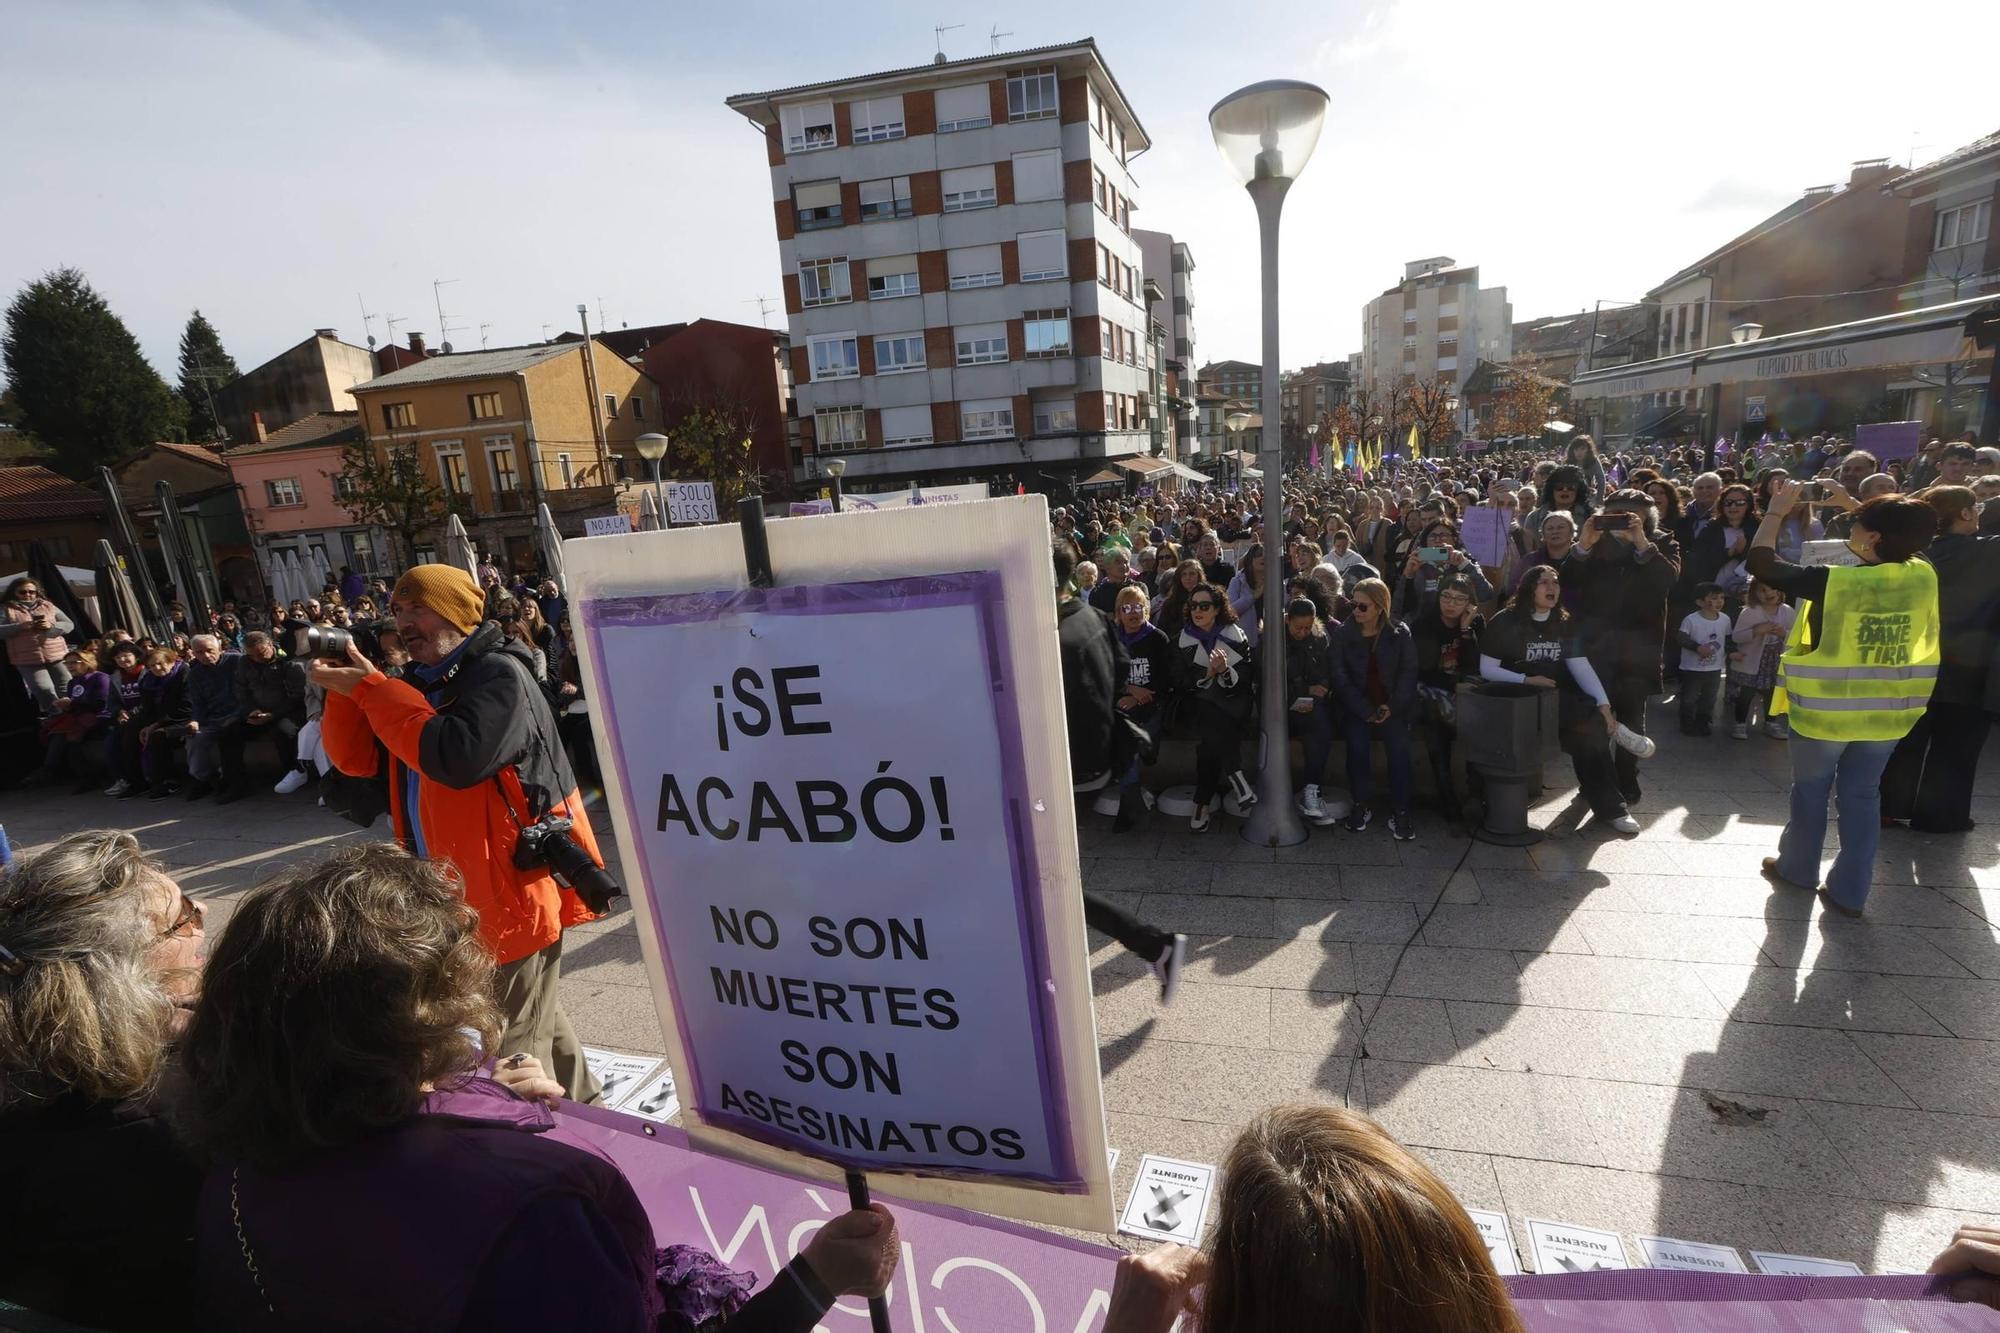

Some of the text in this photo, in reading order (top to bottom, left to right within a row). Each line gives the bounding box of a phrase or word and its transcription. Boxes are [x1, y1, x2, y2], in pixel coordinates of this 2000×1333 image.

[668, 484, 712, 501] #SOLO
[591, 519, 604, 531] NO
[606, 519, 612, 529] A
[1857, 624, 1911, 645] DAME
[1526, 649, 1561, 661] DAME
[1857, 645, 1909, 665] TIRA
[713, 664, 832, 751] ¡SE
[656, 760, 955, 843] ACABÓ!
[709, 905, 929, 960] NO SON
[709, 966, 960, 1031] MUERTES
[780, 1039, 902, 1095] SON
[721, 1083, 1026, 1161] ASESINATOS
[1152, 1168, 1199, 1182] AUSENTE
[1544, 1234, 1607, 1251] AUSENTE
[1660, 1252, 1726, 1269] AUSENTE
